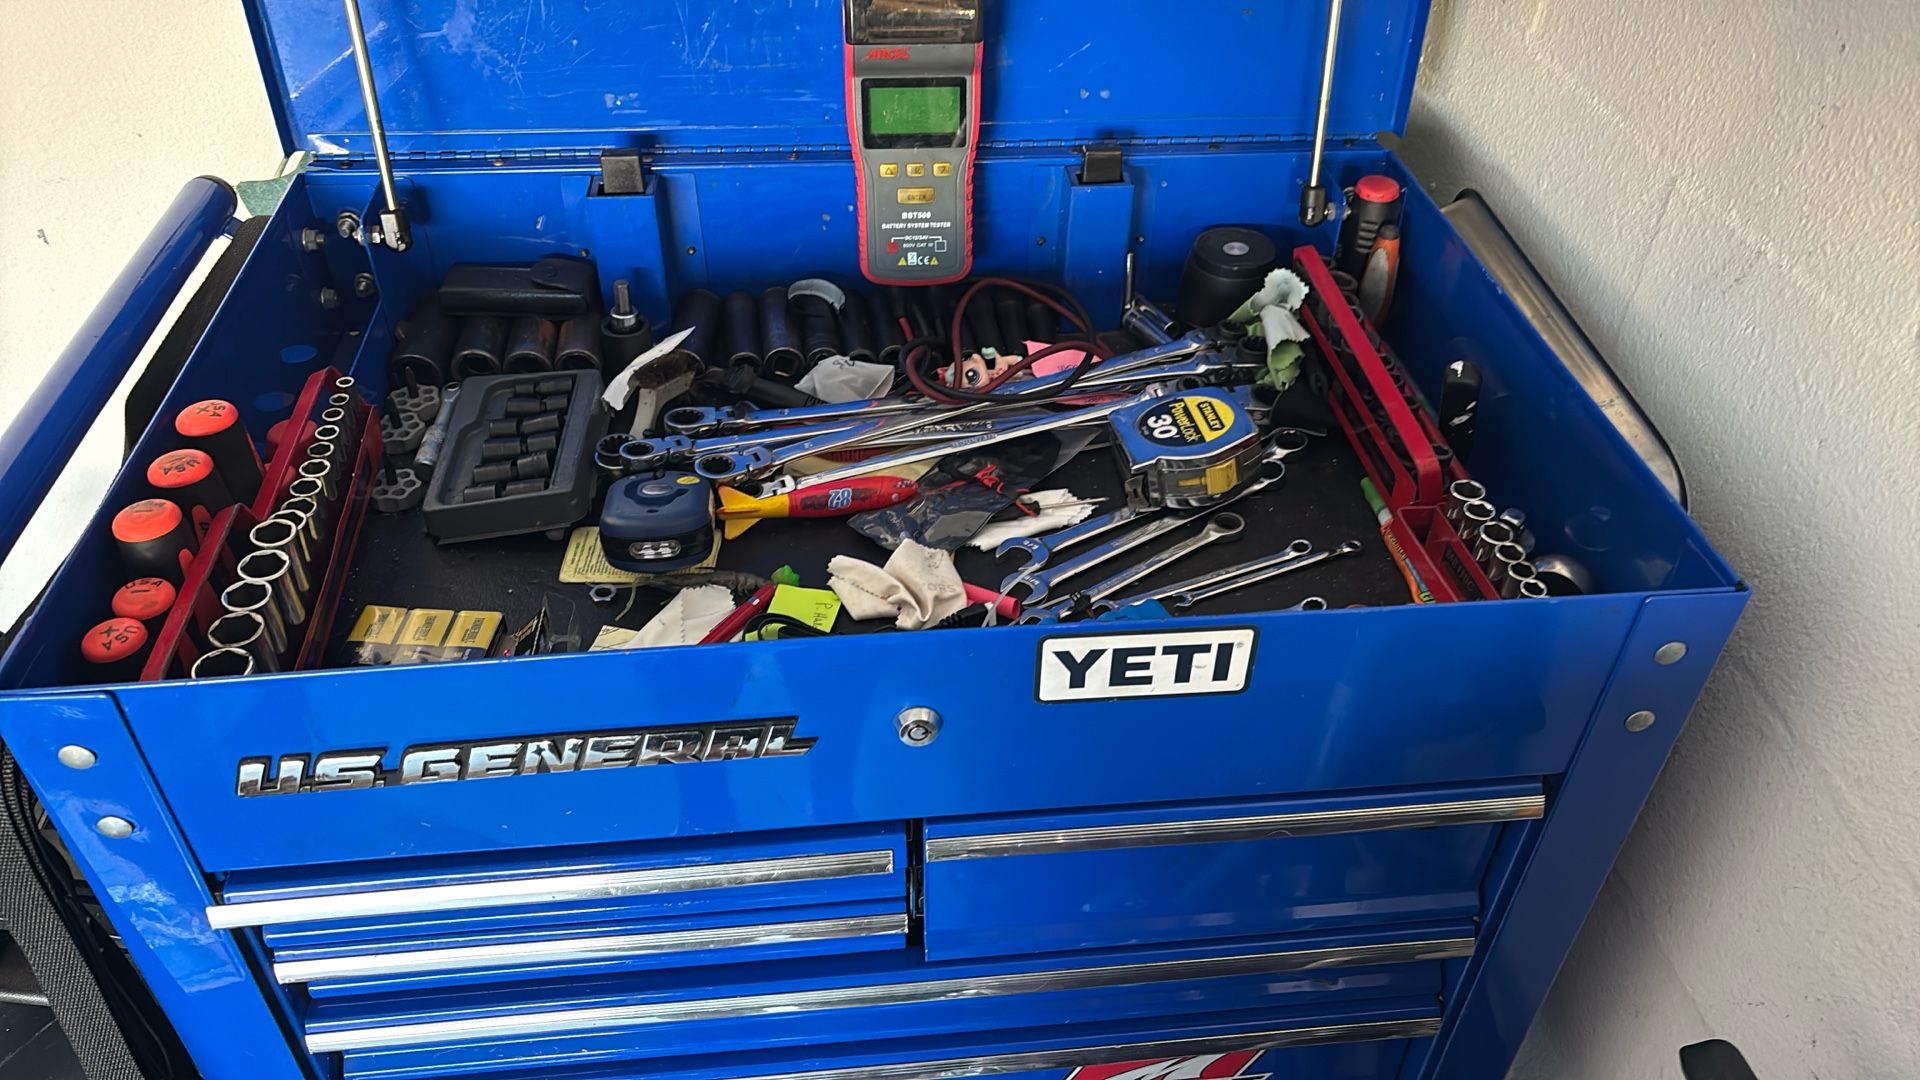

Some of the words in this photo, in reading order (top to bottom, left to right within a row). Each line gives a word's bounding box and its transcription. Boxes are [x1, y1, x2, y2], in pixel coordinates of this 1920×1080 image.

[901, 211, 931, 220] BST500
[1168, 401, 1202, 442] PowerLock
[1199, 401, 1222, 430] STANLEY
[124, 578, 163, 592] USA
[101, 624, 140, 651] USA
[1051, 642, 1235, 690] YETI
[401, 716, 819, 787] GENERAL
